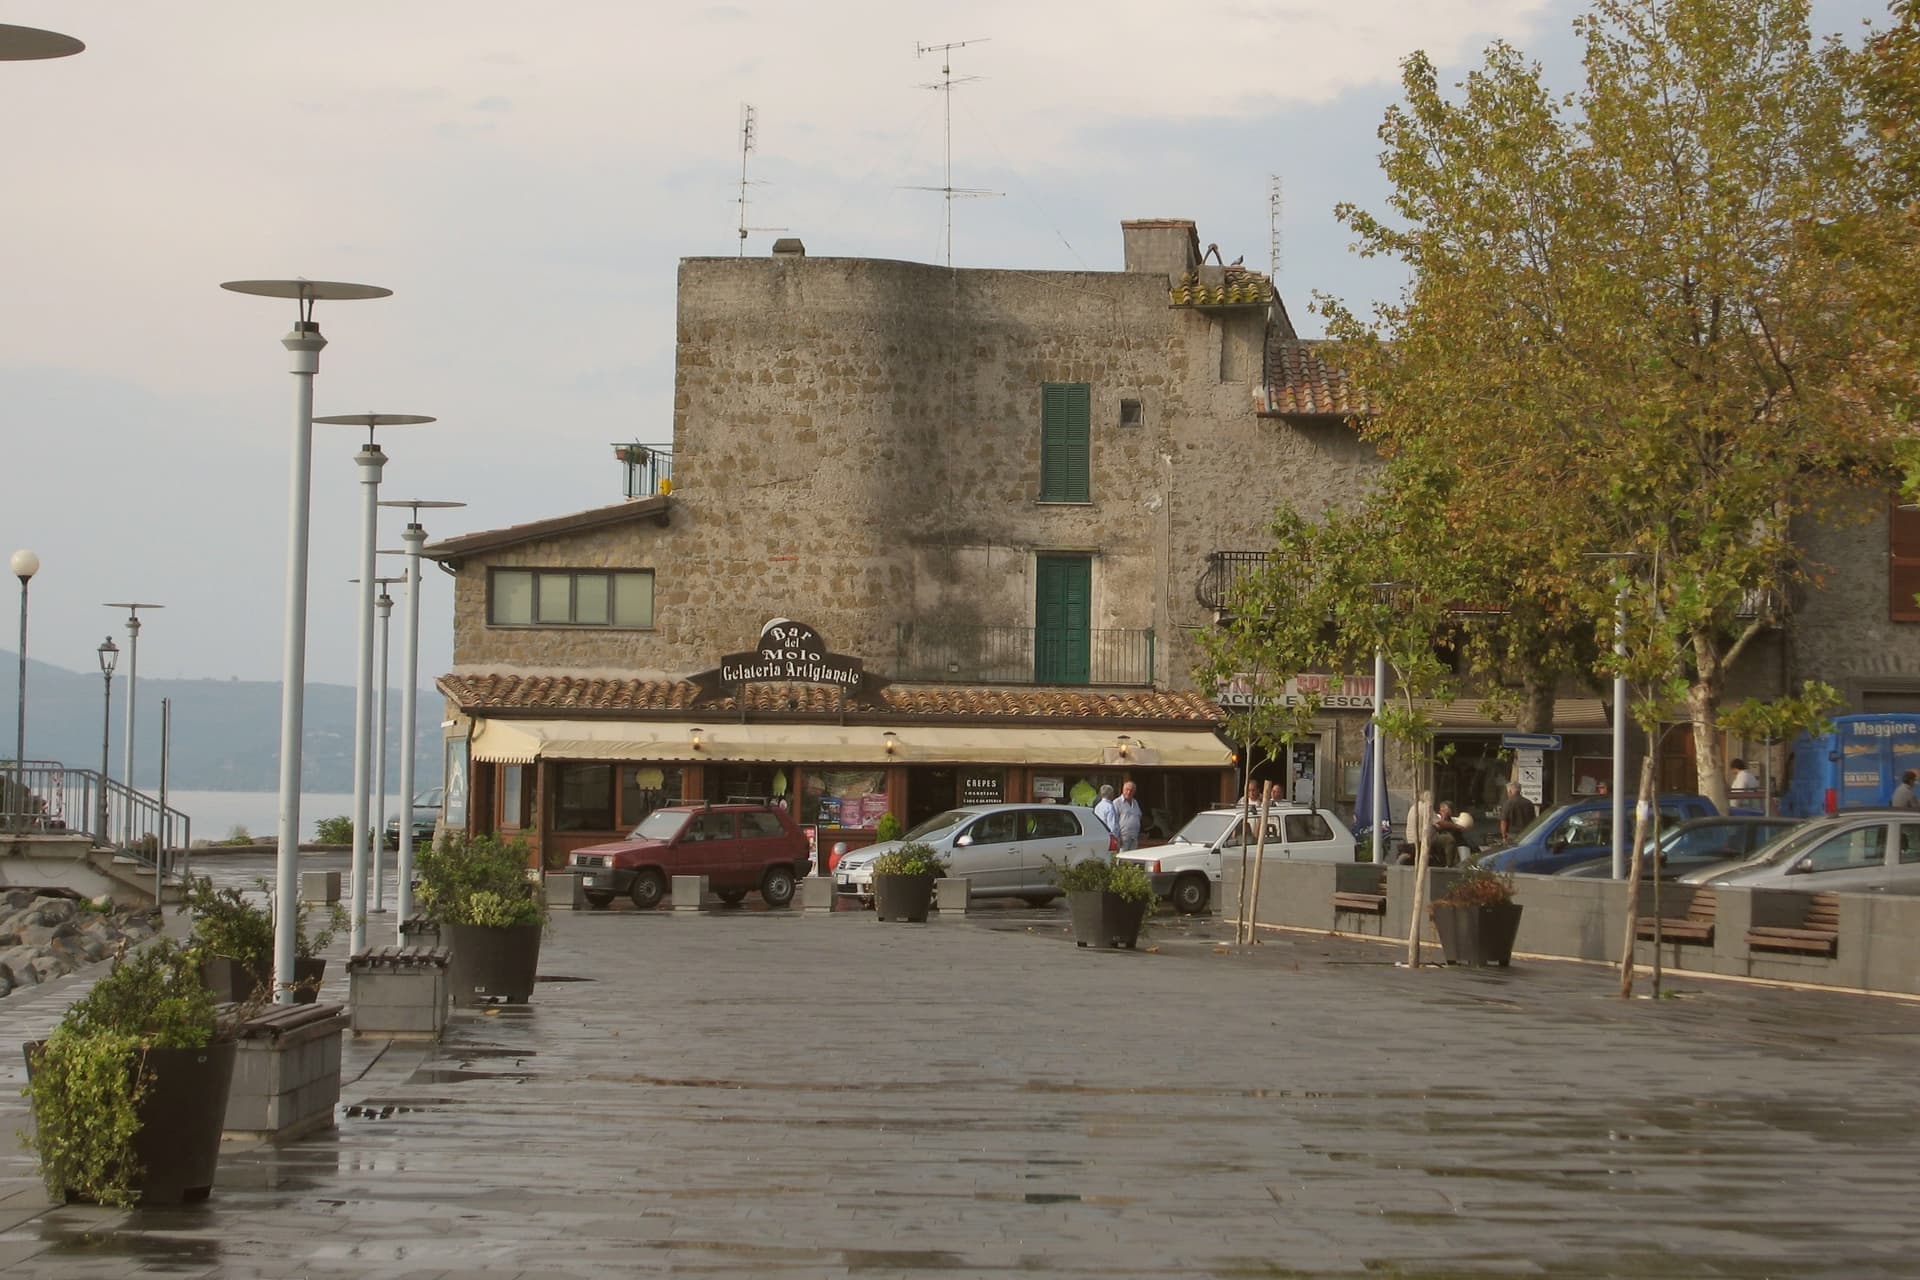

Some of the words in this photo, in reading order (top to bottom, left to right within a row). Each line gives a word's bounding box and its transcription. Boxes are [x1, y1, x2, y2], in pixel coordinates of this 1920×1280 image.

[771, 627, 812, 641] Bar
[785, 638, 799, 648] del
[762, 650, 821, 661] Molo
[723, 663, 781, 681] Gelateria
[786, 661, 859, 684] Artigianale
[1220, 694, 1275, 706] ACCIA
[1286, 695, 1298, 706] E
[1323, 696, 1373, 707] ESCA
[1853, 720, 1917, 737] Maggiore
[966, 779, 997, 788] CREPES
